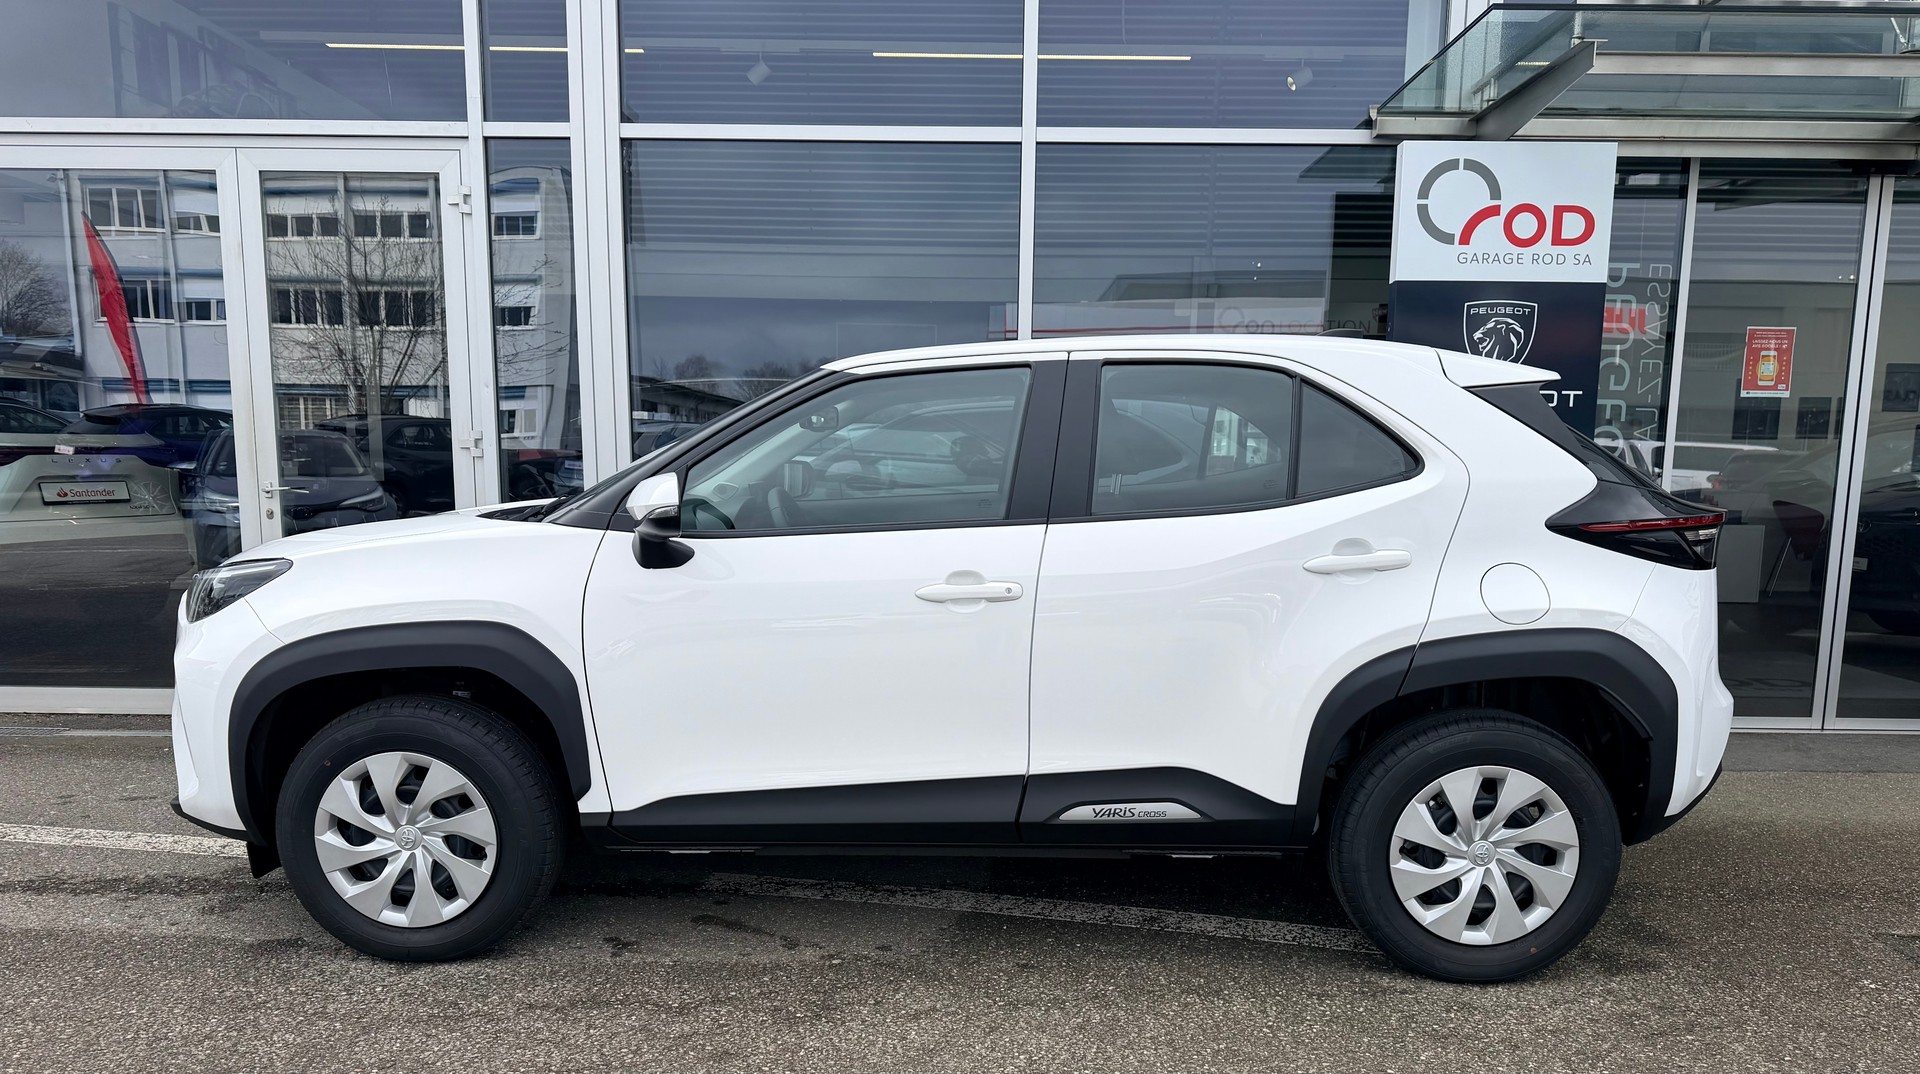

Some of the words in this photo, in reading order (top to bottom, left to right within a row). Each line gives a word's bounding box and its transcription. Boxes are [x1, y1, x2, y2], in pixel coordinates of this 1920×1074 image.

[1456, 252, 1525, 265] GARAGE
[1531, 253, 1567, 266] ROD
[1572, 253, 1592, 266] SA
[1470, 306, 1531, 315] PEUGEOT
[69, 488, 116, 498] Santander
